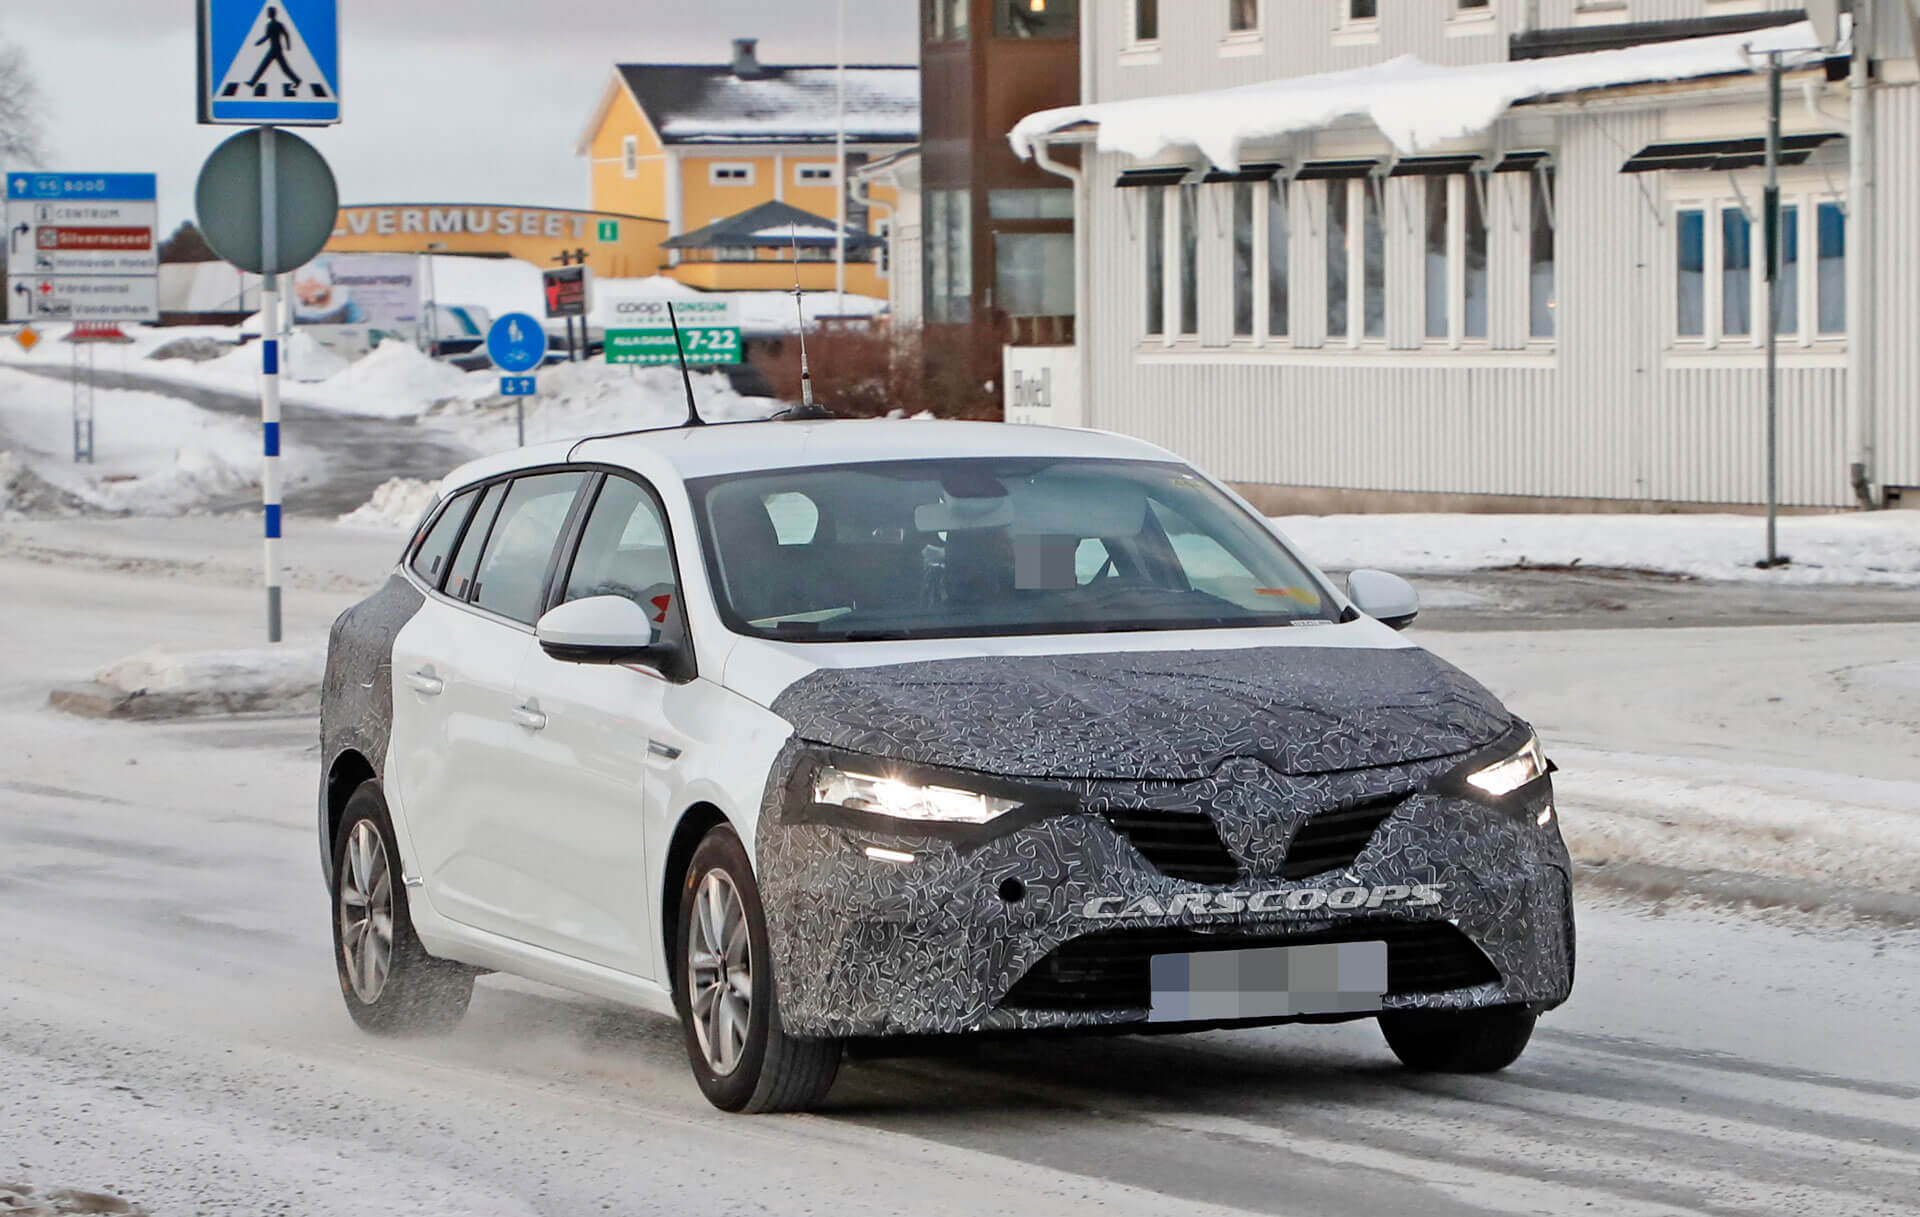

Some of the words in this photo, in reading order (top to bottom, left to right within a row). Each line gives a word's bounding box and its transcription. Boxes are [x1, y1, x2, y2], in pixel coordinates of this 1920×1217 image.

[56, 208, 121, 219] CENTRUM
[59, 231, 149, 245] Silvermuseet
[616, 302, 662, 314] coop
[685, 329, 737, 350] 7-22
